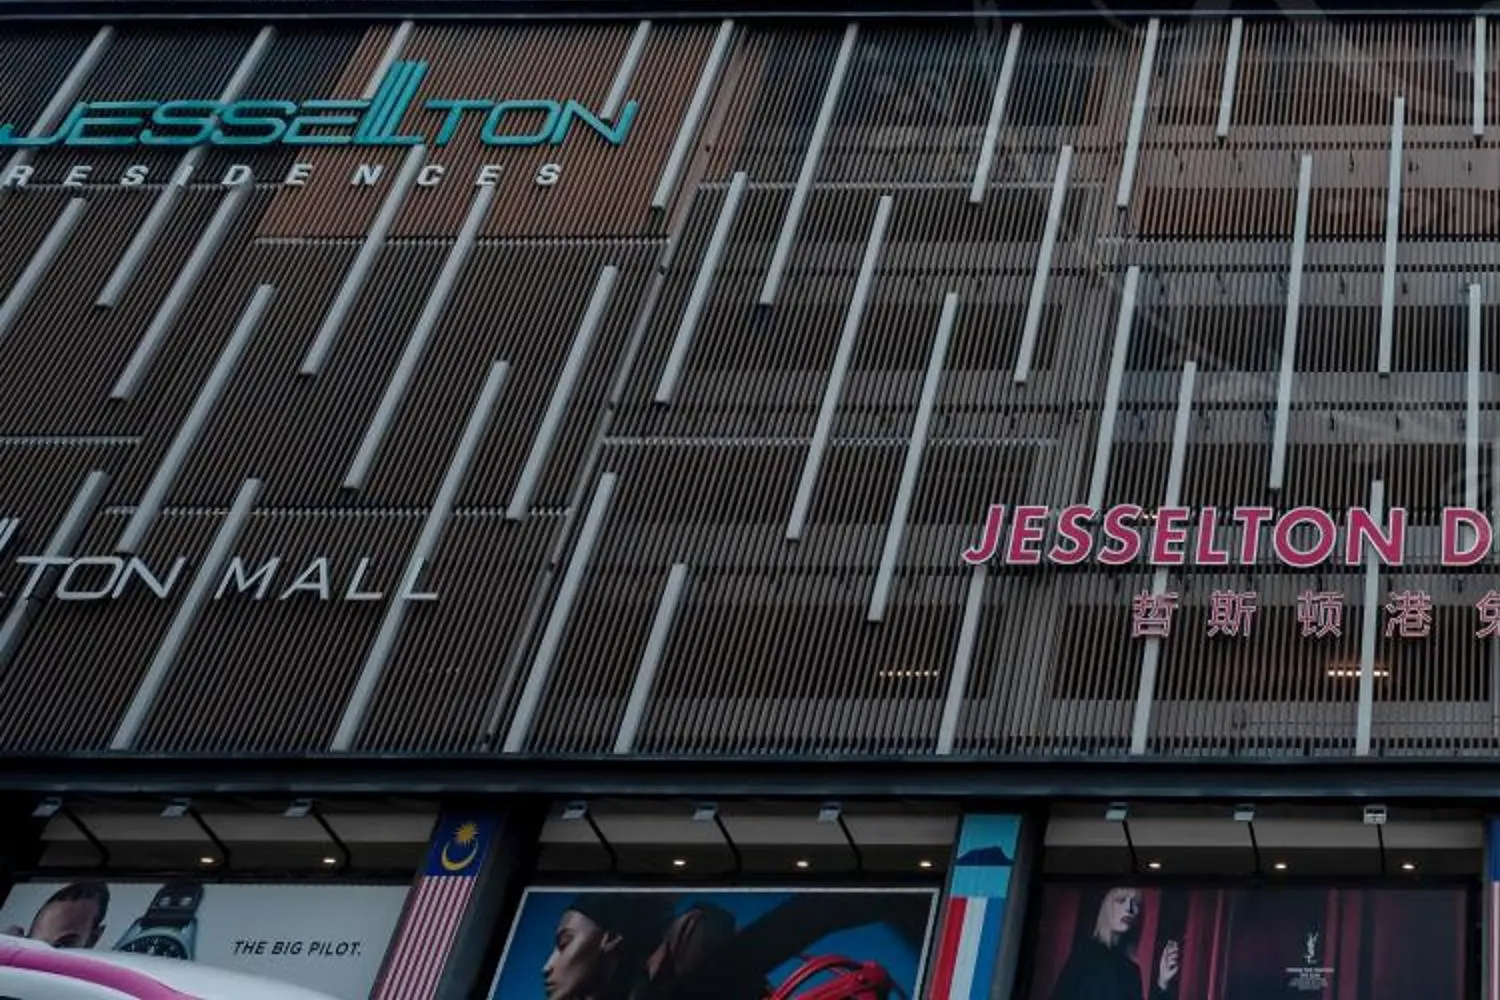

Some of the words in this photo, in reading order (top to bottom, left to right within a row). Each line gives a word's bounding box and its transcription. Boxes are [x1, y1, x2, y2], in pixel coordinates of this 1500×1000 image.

[3, 164, 562, 188] RESIDENCES
[963, 504, 1405, 567] JESSELTON
[214, 557, 439, 601] MALL
[233, 941, 268, 955] THE
[272, 941, 303, 955] BIG
[307, 941, 361, 956] PILOT.
